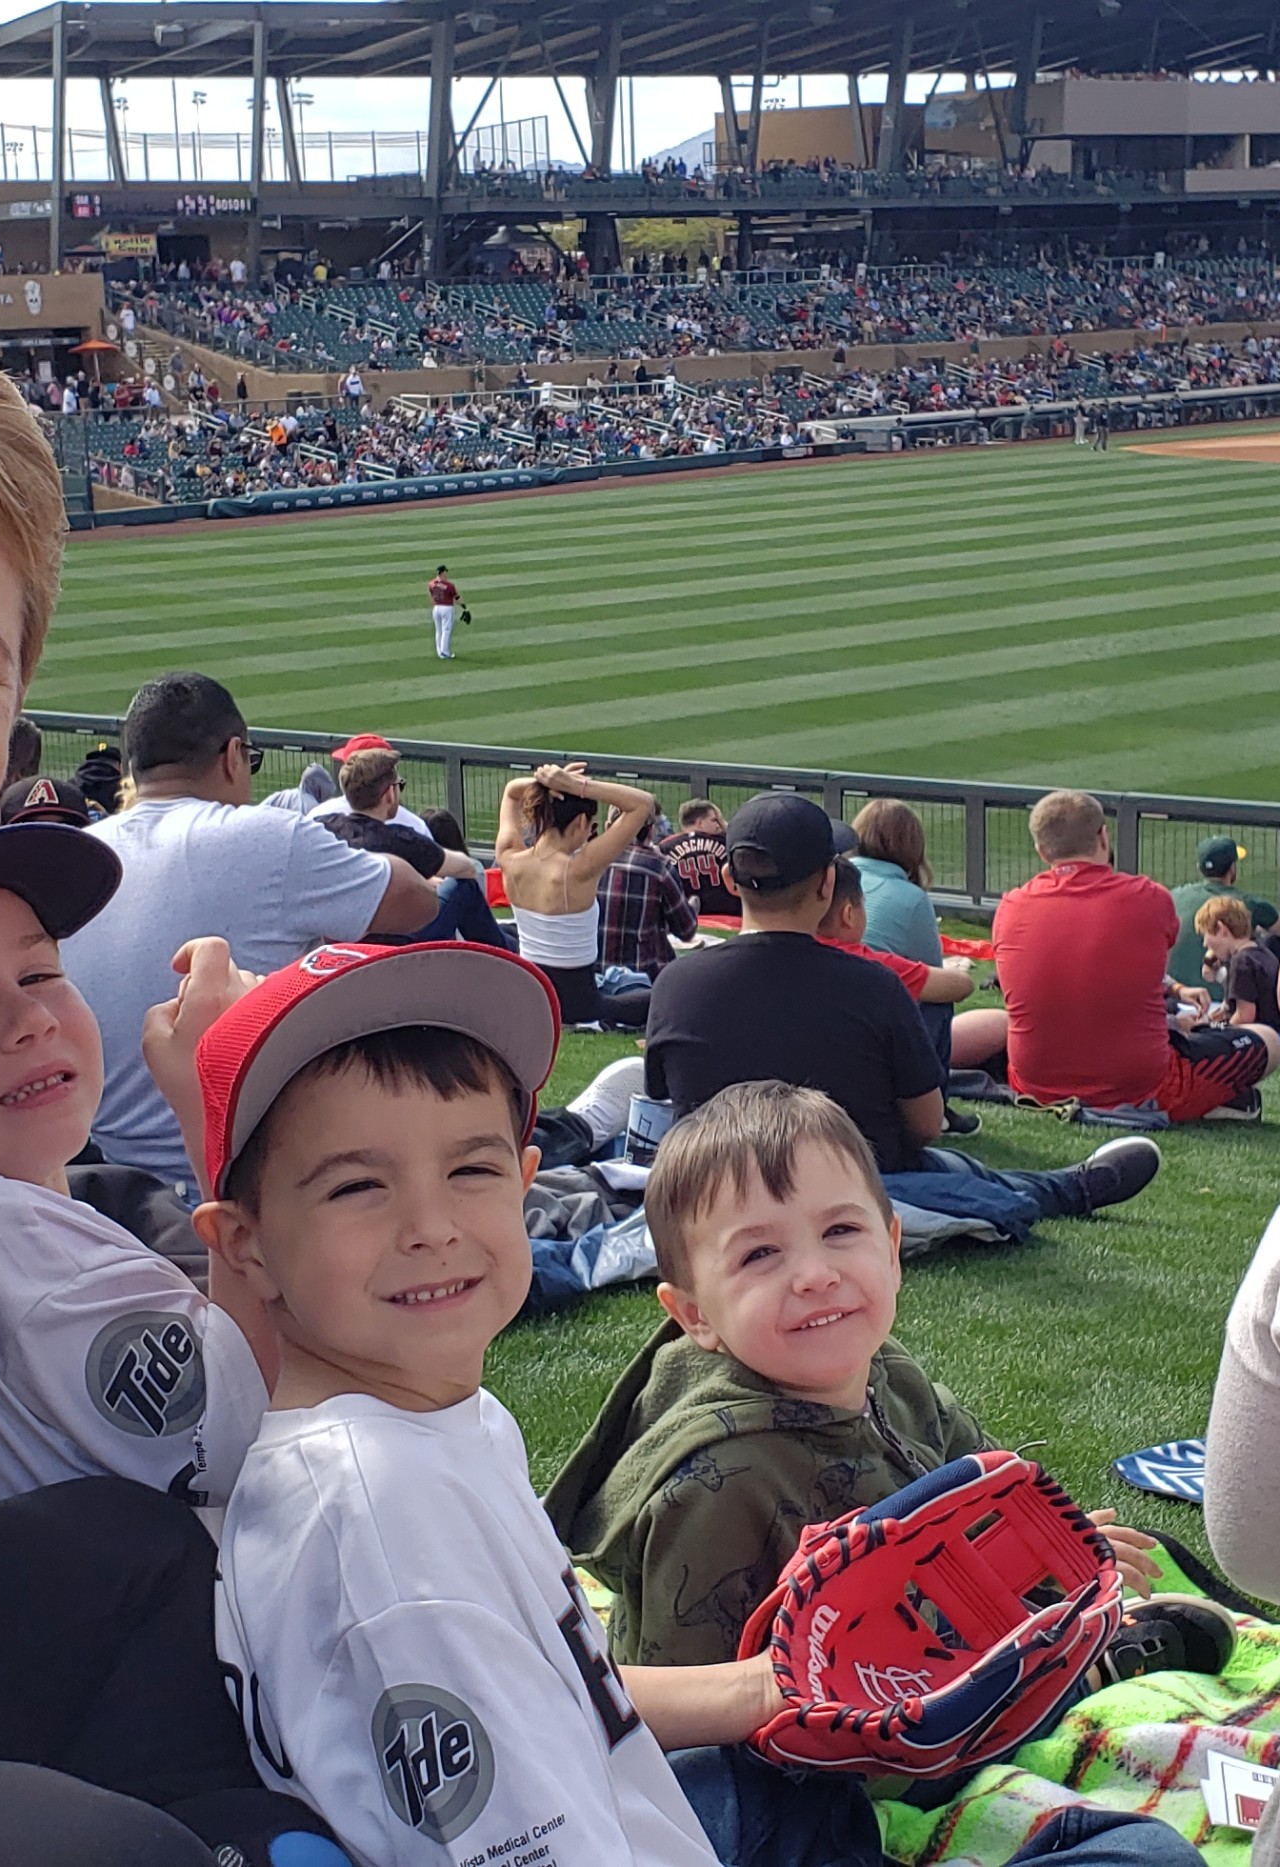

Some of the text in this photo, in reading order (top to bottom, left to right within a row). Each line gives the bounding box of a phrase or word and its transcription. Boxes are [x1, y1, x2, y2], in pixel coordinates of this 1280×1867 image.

[678, 853, 720, 890] 44
[103, 1320, 196, 1437] Tide
[196, 1441, 208, 1473] Tempe
[807, 1604, 841, 1703] Wilson
[383, 1711, 475, 1829] Tde
[486, 1831, 531, 1860] Medical
[532, 1813, 566, 1839] Center
[513, 1844, 551, 1867] Center
